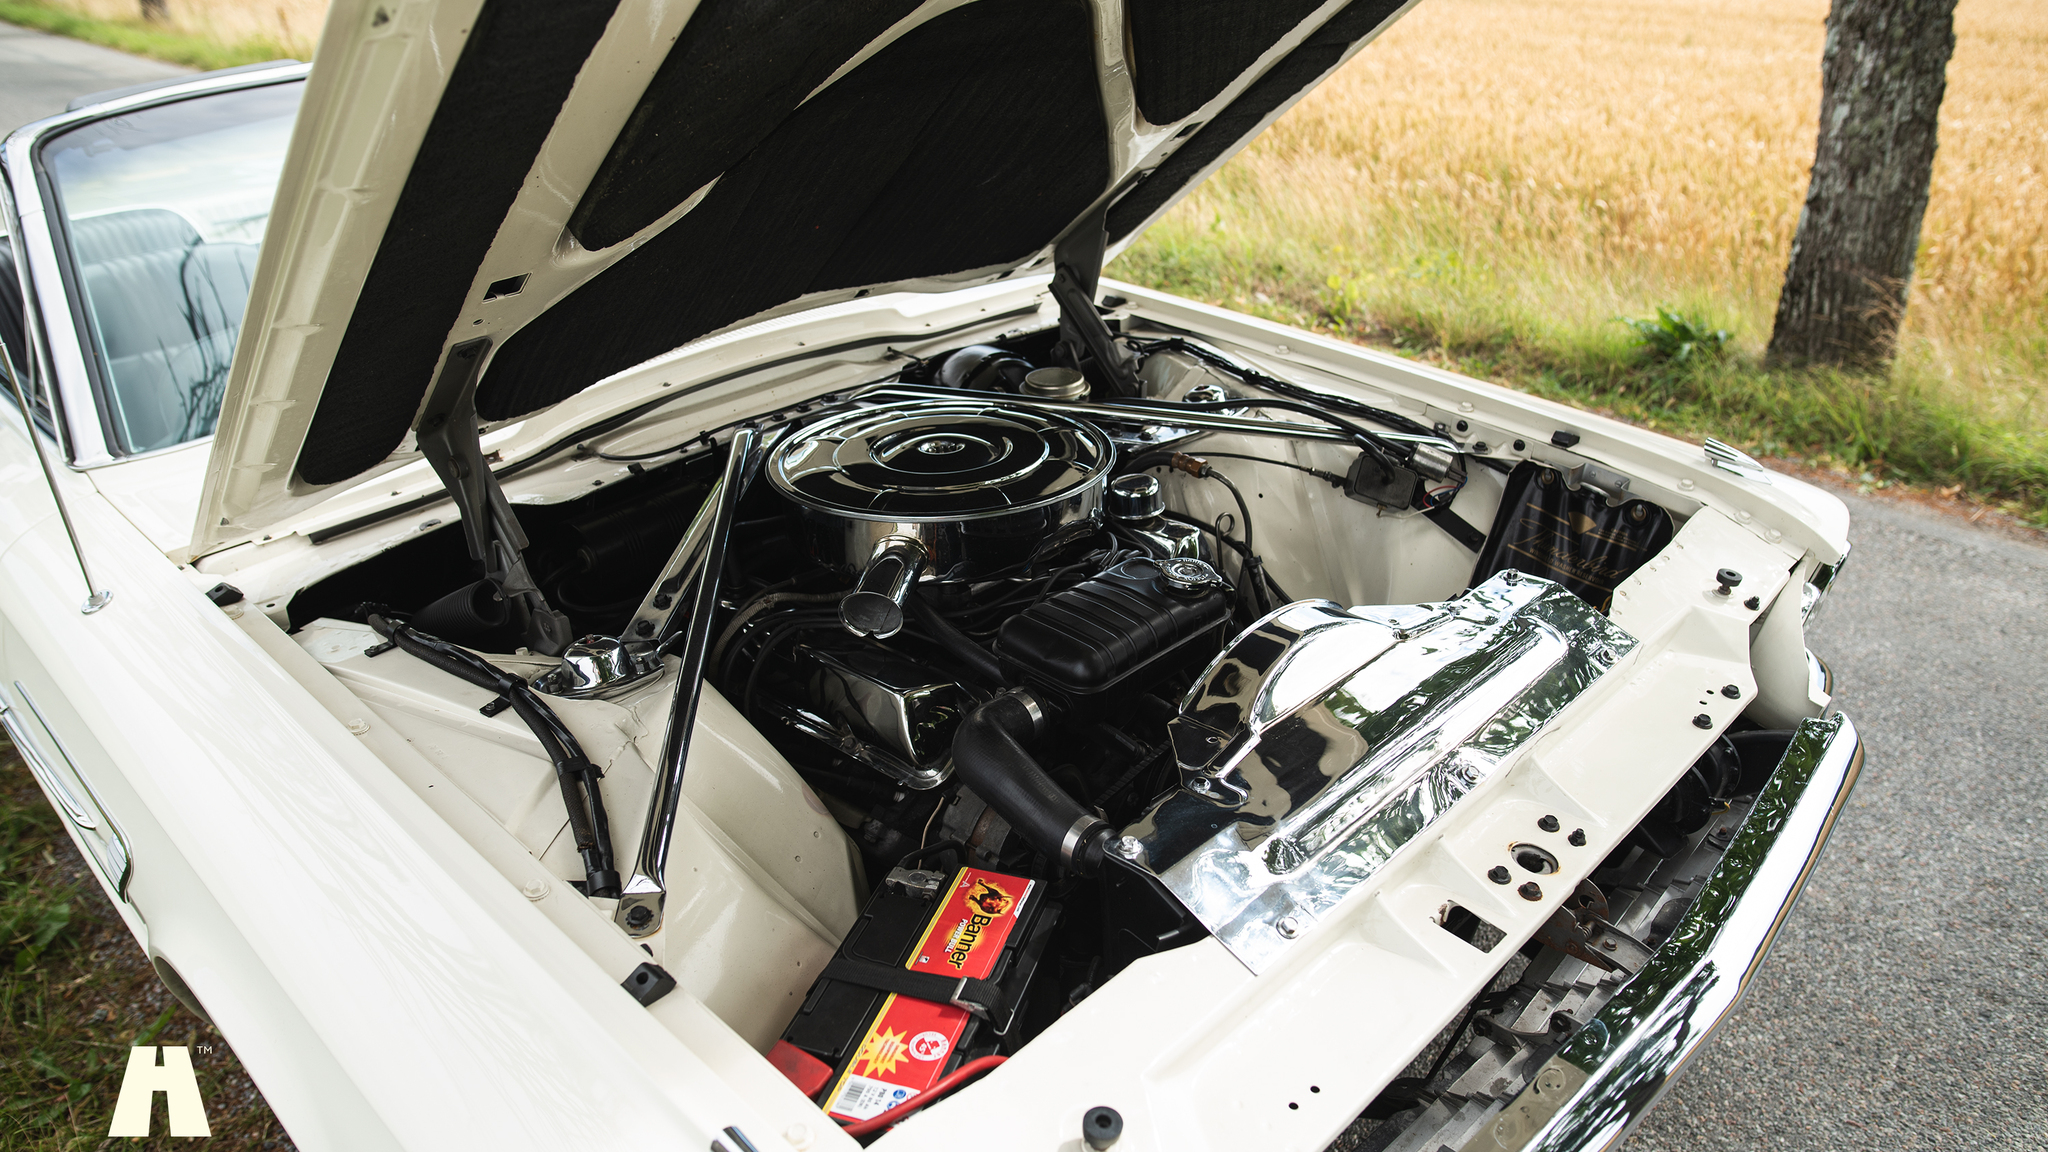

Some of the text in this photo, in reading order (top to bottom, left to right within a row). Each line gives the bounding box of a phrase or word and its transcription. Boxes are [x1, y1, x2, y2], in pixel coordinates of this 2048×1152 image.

[1513, 518, 1629, 579] Thunderbird
[944, 918, 968, 952] POWER BULL
[949, 914, 992, 969] Banner
